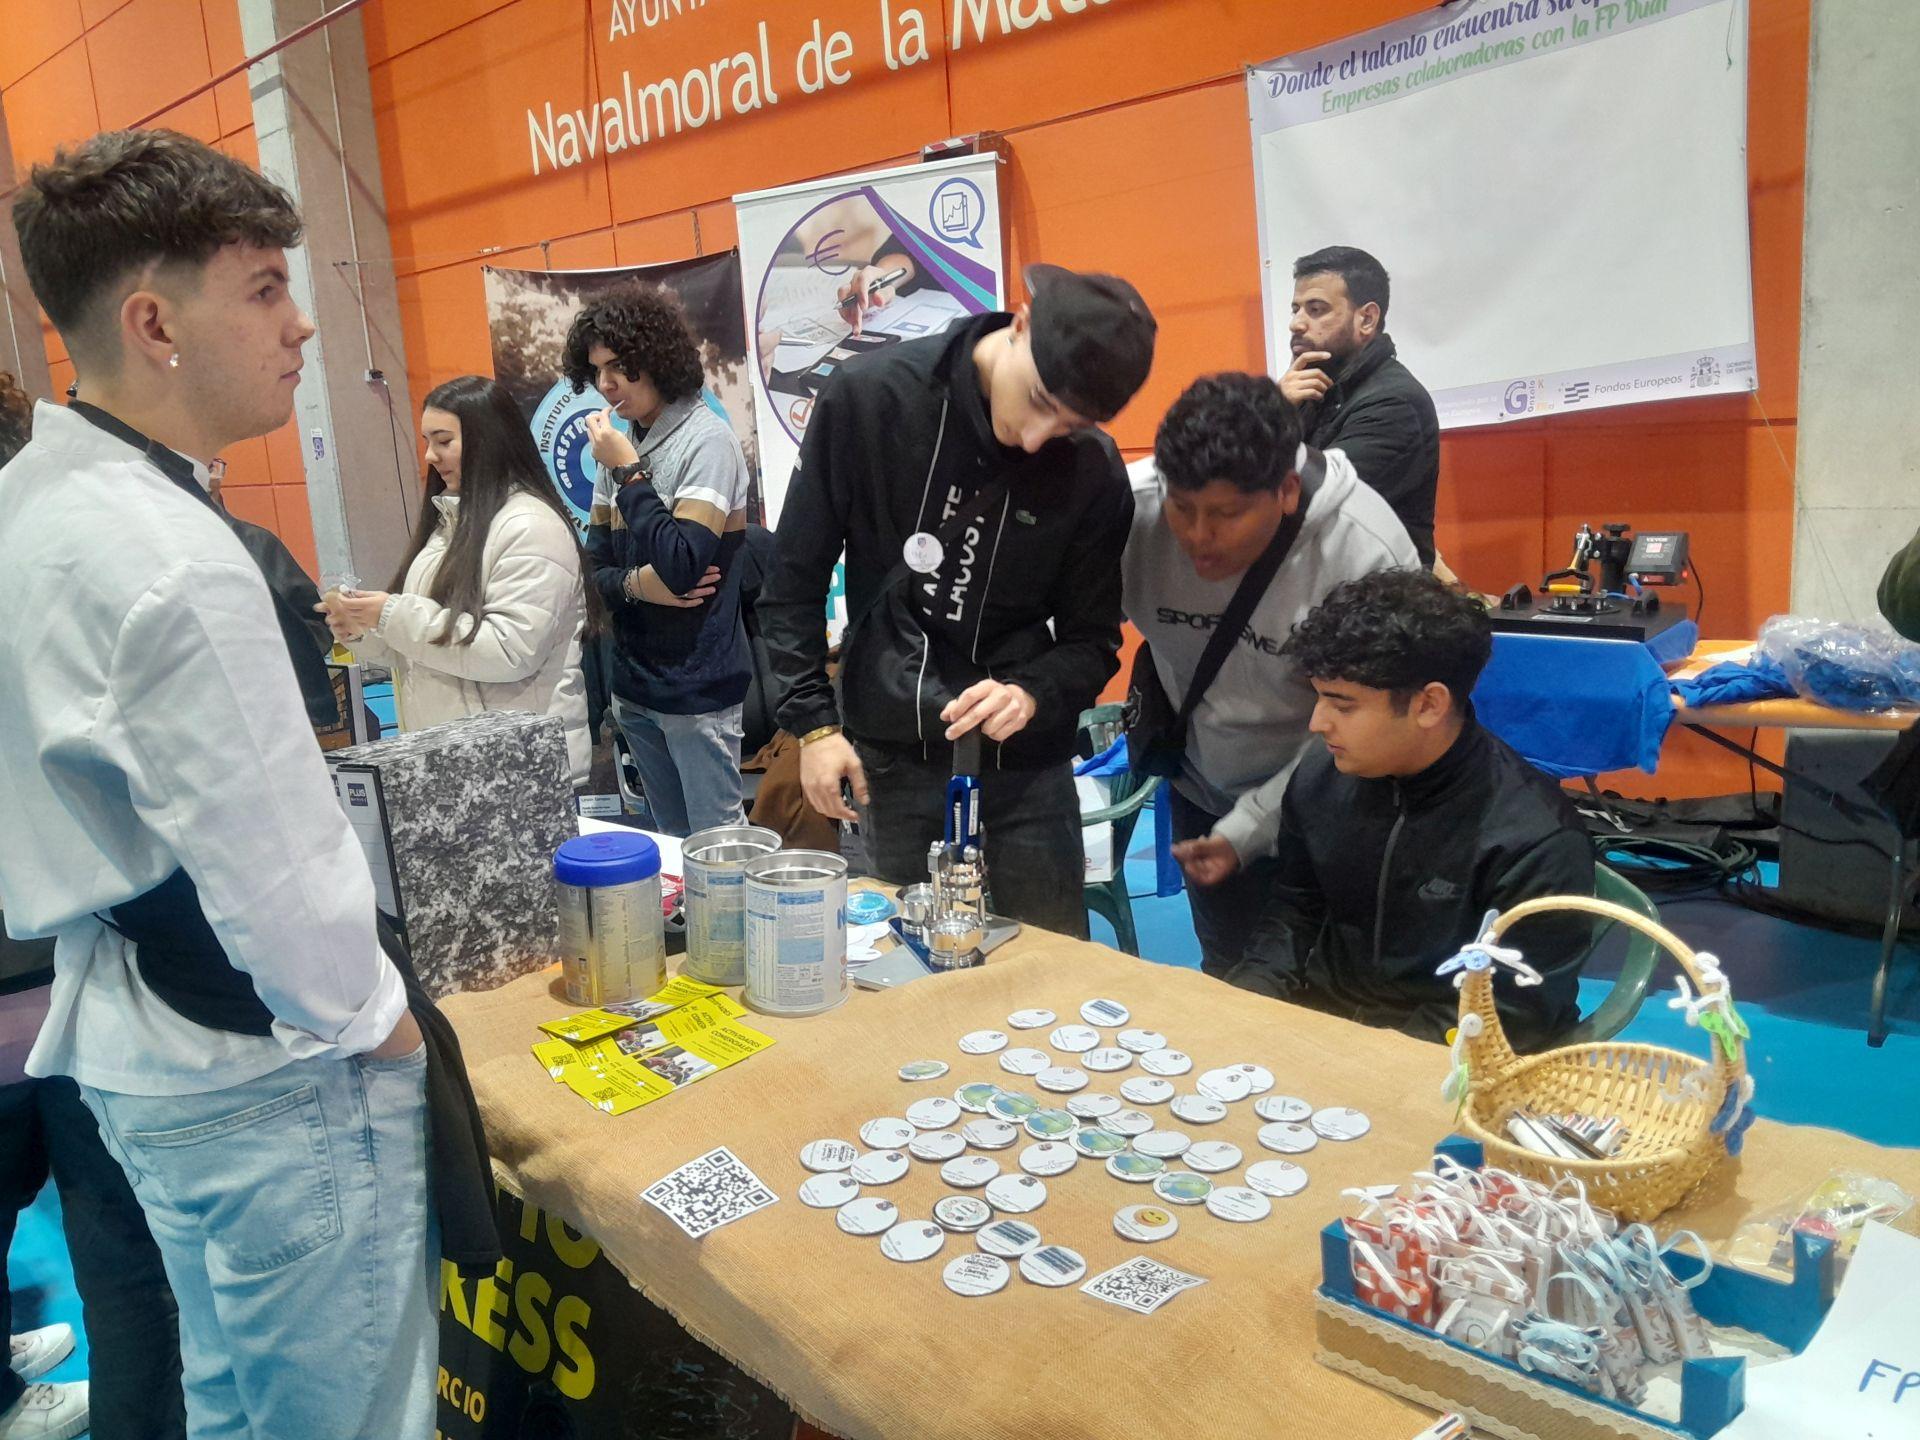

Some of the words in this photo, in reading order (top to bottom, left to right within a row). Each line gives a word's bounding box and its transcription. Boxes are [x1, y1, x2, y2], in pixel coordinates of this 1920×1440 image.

[1267, 61, 1335, 99] Donde
[1339, 51, 1358, 81] el
[1361, 34, 1427, 75] talento
[1433, 1, 1541, 51] encuentra
[1322, 75, 1400, 114] Empresas
[1405, 36, 1526, 89] colaboradoras
[1532, 26, 1564, 50] con
[1571, 13, 1589, 40] la
[1594, 3, 1620, 32] FP
[527, 21, 778, 175] Navalmoral
[796, 19, 852, 93] de
[881, 0, 929, 70] la
[1594, 382, 1632, 394] Fondos
[1633, 374, 1683, 389] Europeos
[720, 1026, 762, 1048] ACTIVIDADES
[1858, 1358, 1920, 1404] FP
